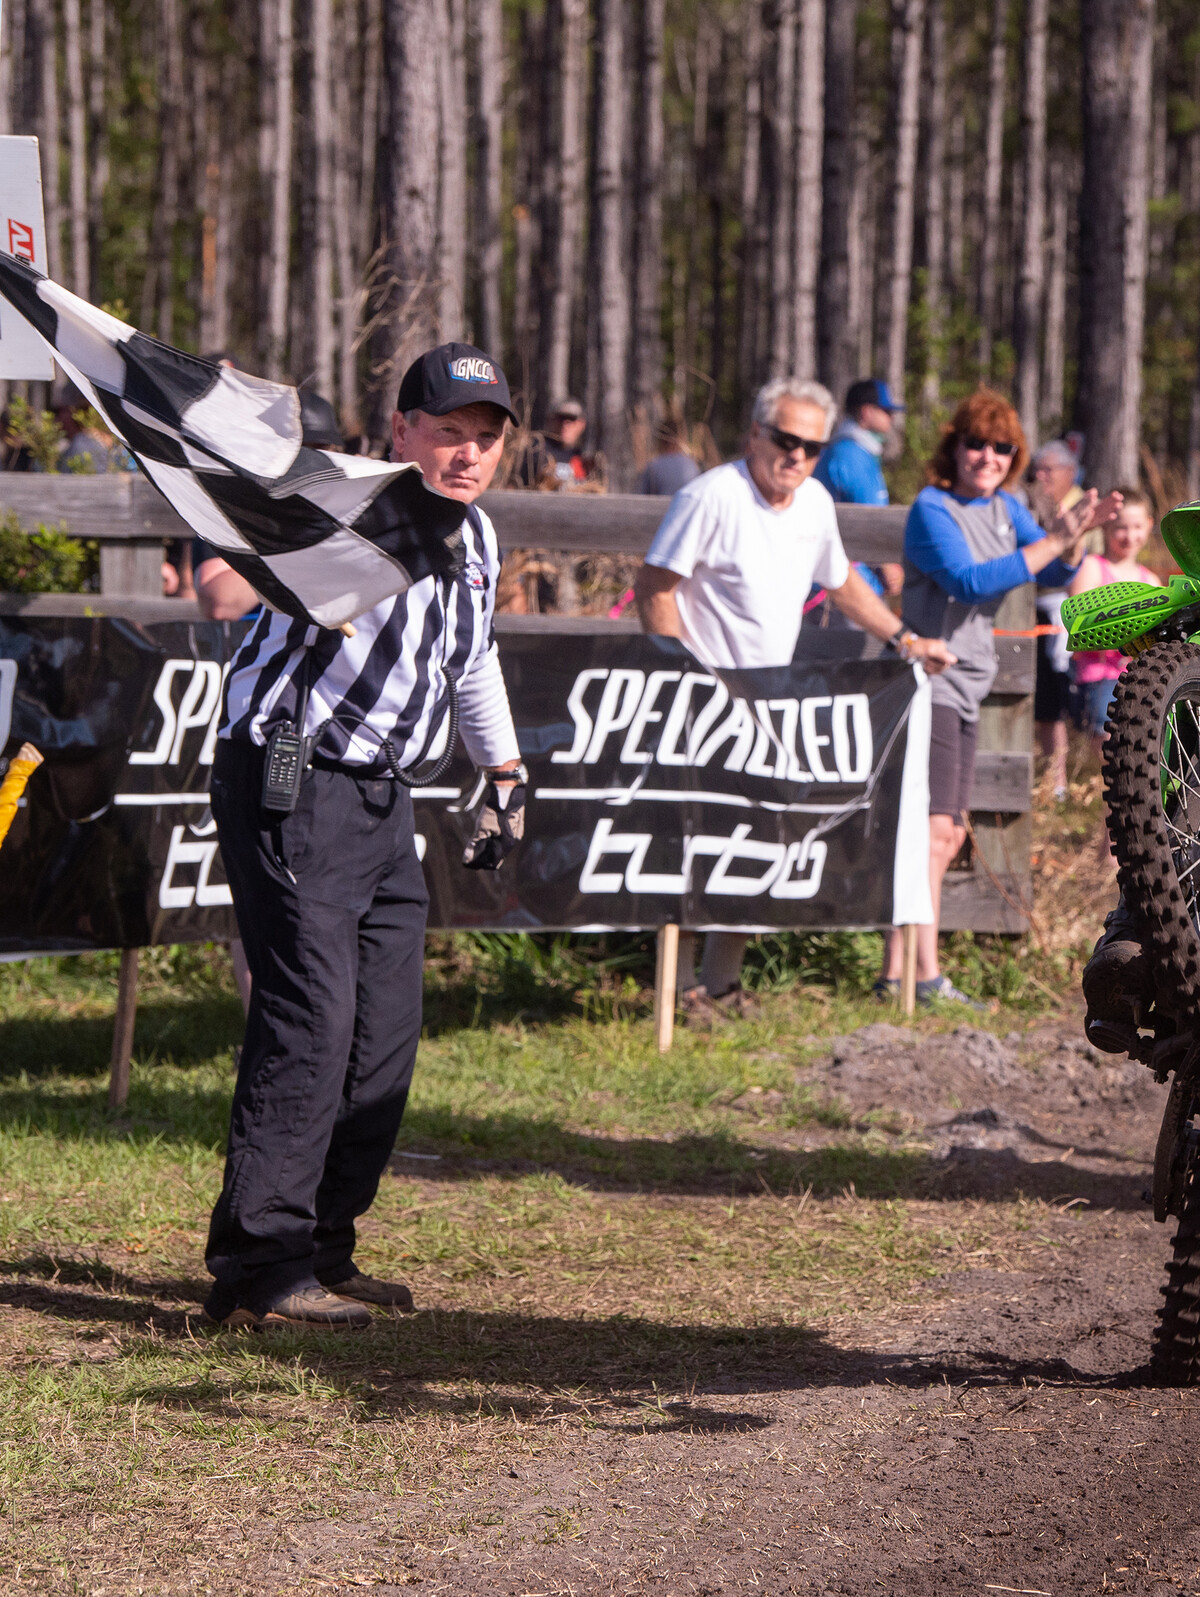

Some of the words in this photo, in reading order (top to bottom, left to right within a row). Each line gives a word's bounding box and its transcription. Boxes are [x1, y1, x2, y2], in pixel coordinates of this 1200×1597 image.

[457, 358, 491, 380] GNCC
[1094, 595, 1170, 622] ACERBIS
[551, 668, 874, 783] SPECIALIZED
[579, 818, 828, 899] turbo
